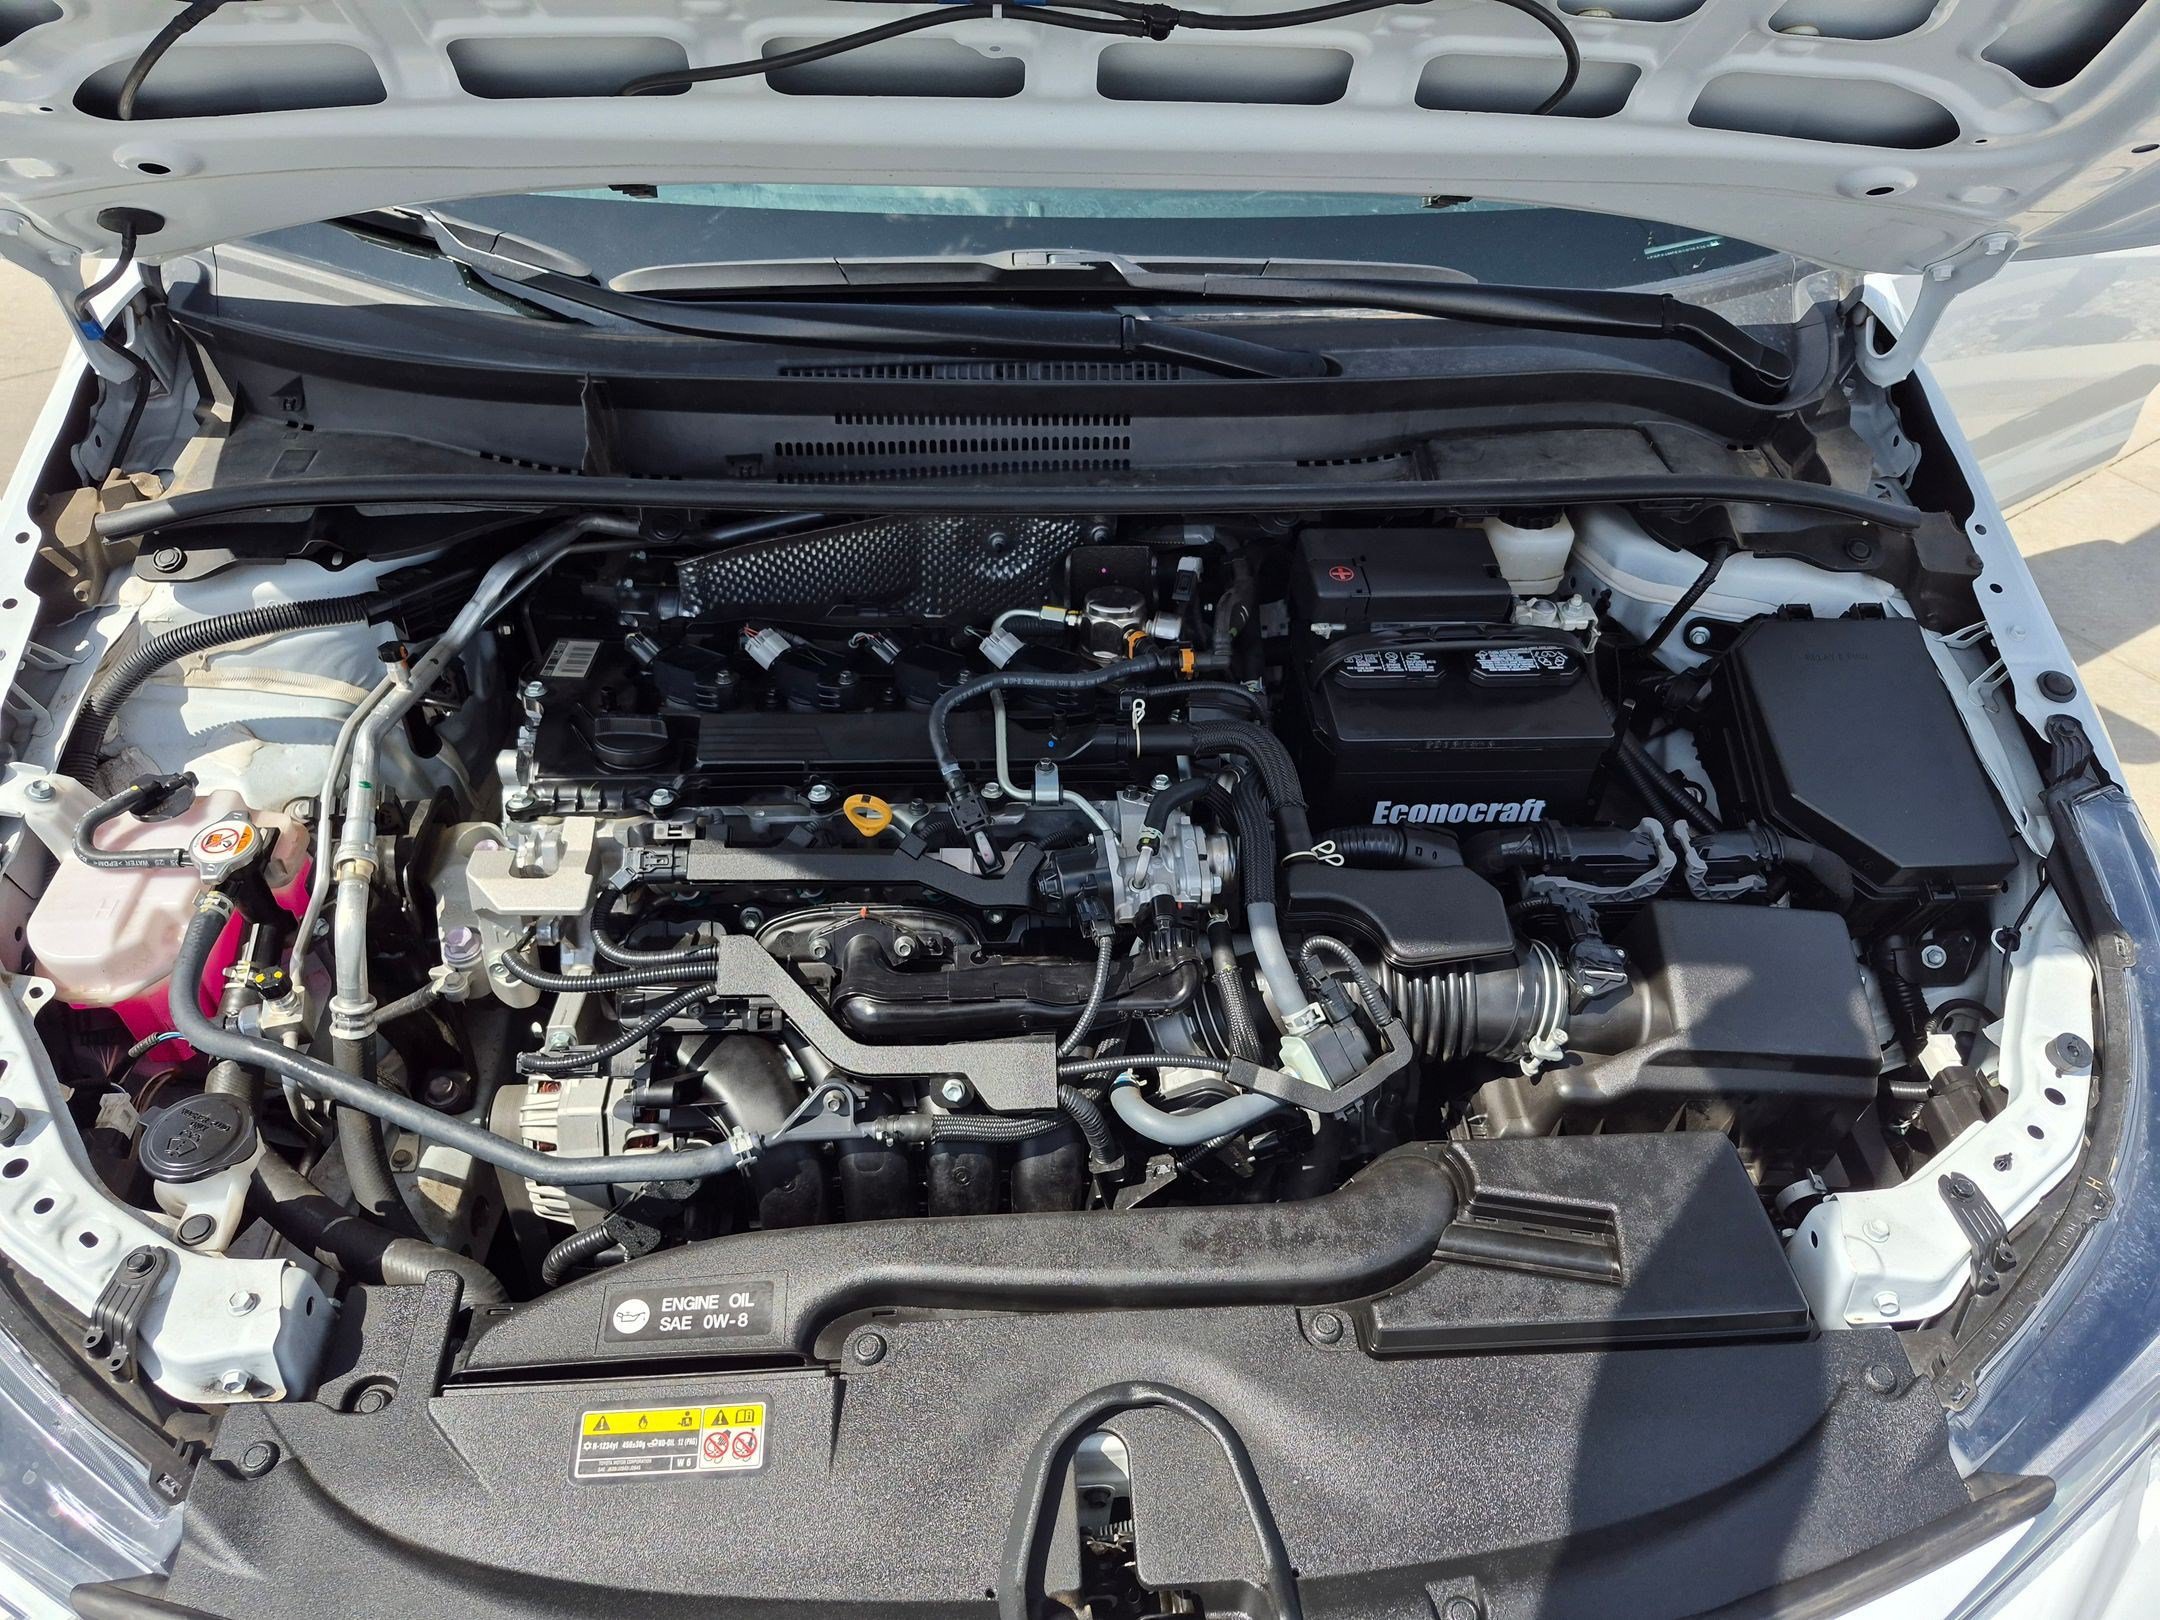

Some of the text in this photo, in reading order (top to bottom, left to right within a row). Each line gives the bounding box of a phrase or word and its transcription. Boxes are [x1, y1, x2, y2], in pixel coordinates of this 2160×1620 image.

[1372, 799, 1546, 825] Econocraft
[661, 1292, 755, 1312] ENGINE OIL
[659, 1312, 748, 1331] SAE 0W-8
[676, 1458, 686, 1467] W
